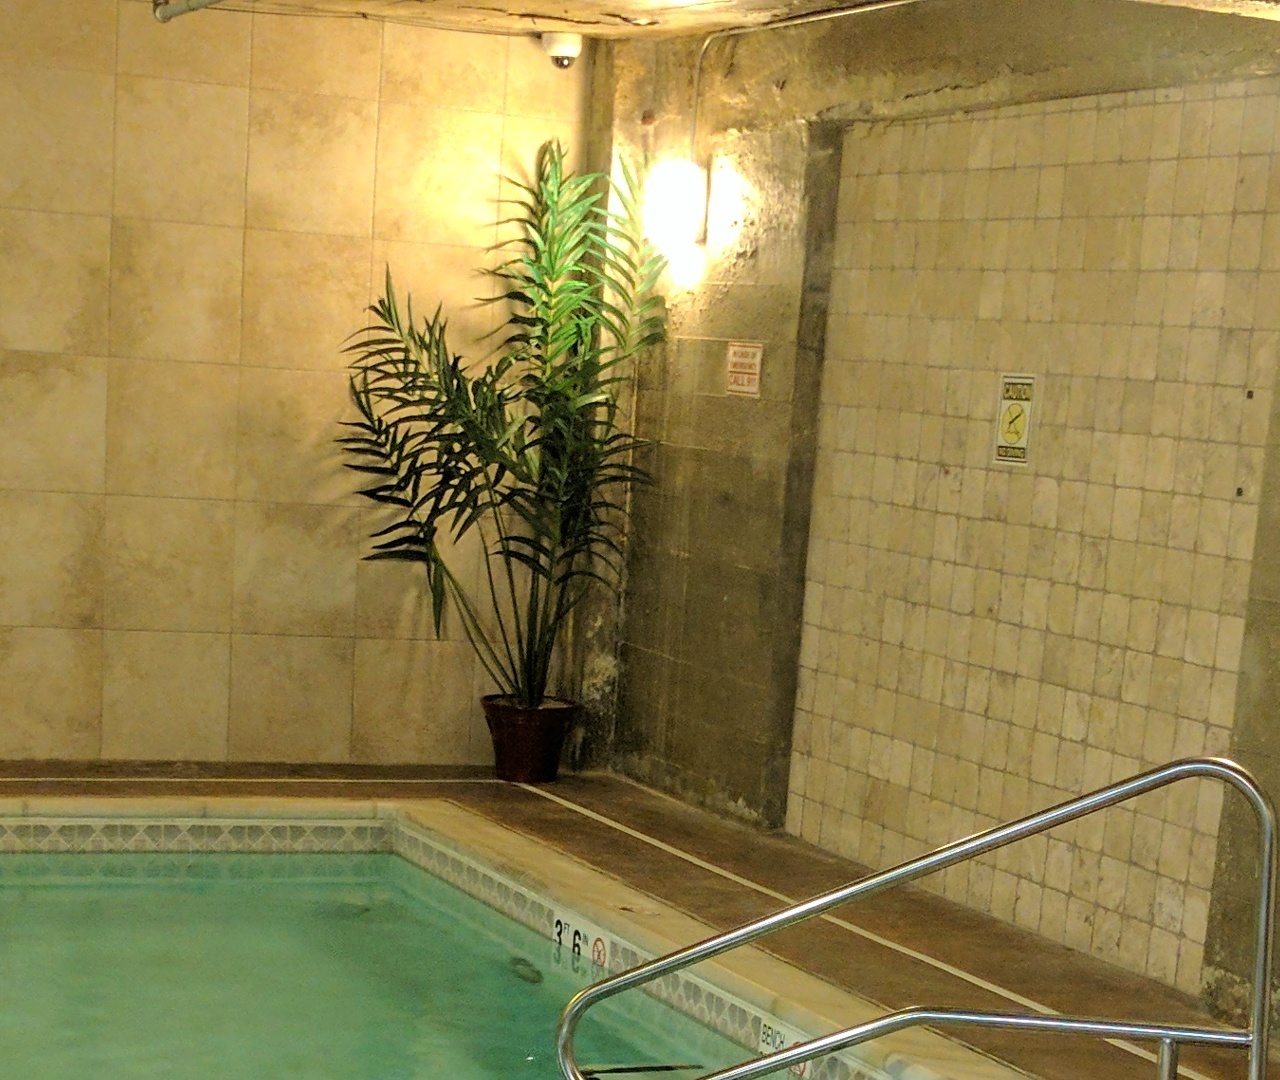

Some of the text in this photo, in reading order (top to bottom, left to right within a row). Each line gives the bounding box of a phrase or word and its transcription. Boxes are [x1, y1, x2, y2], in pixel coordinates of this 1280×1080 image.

[555, 919, 563, 946] 3
[572, 929, 581, 956] 6
[762, 1023, 785, 1049] BENCH
